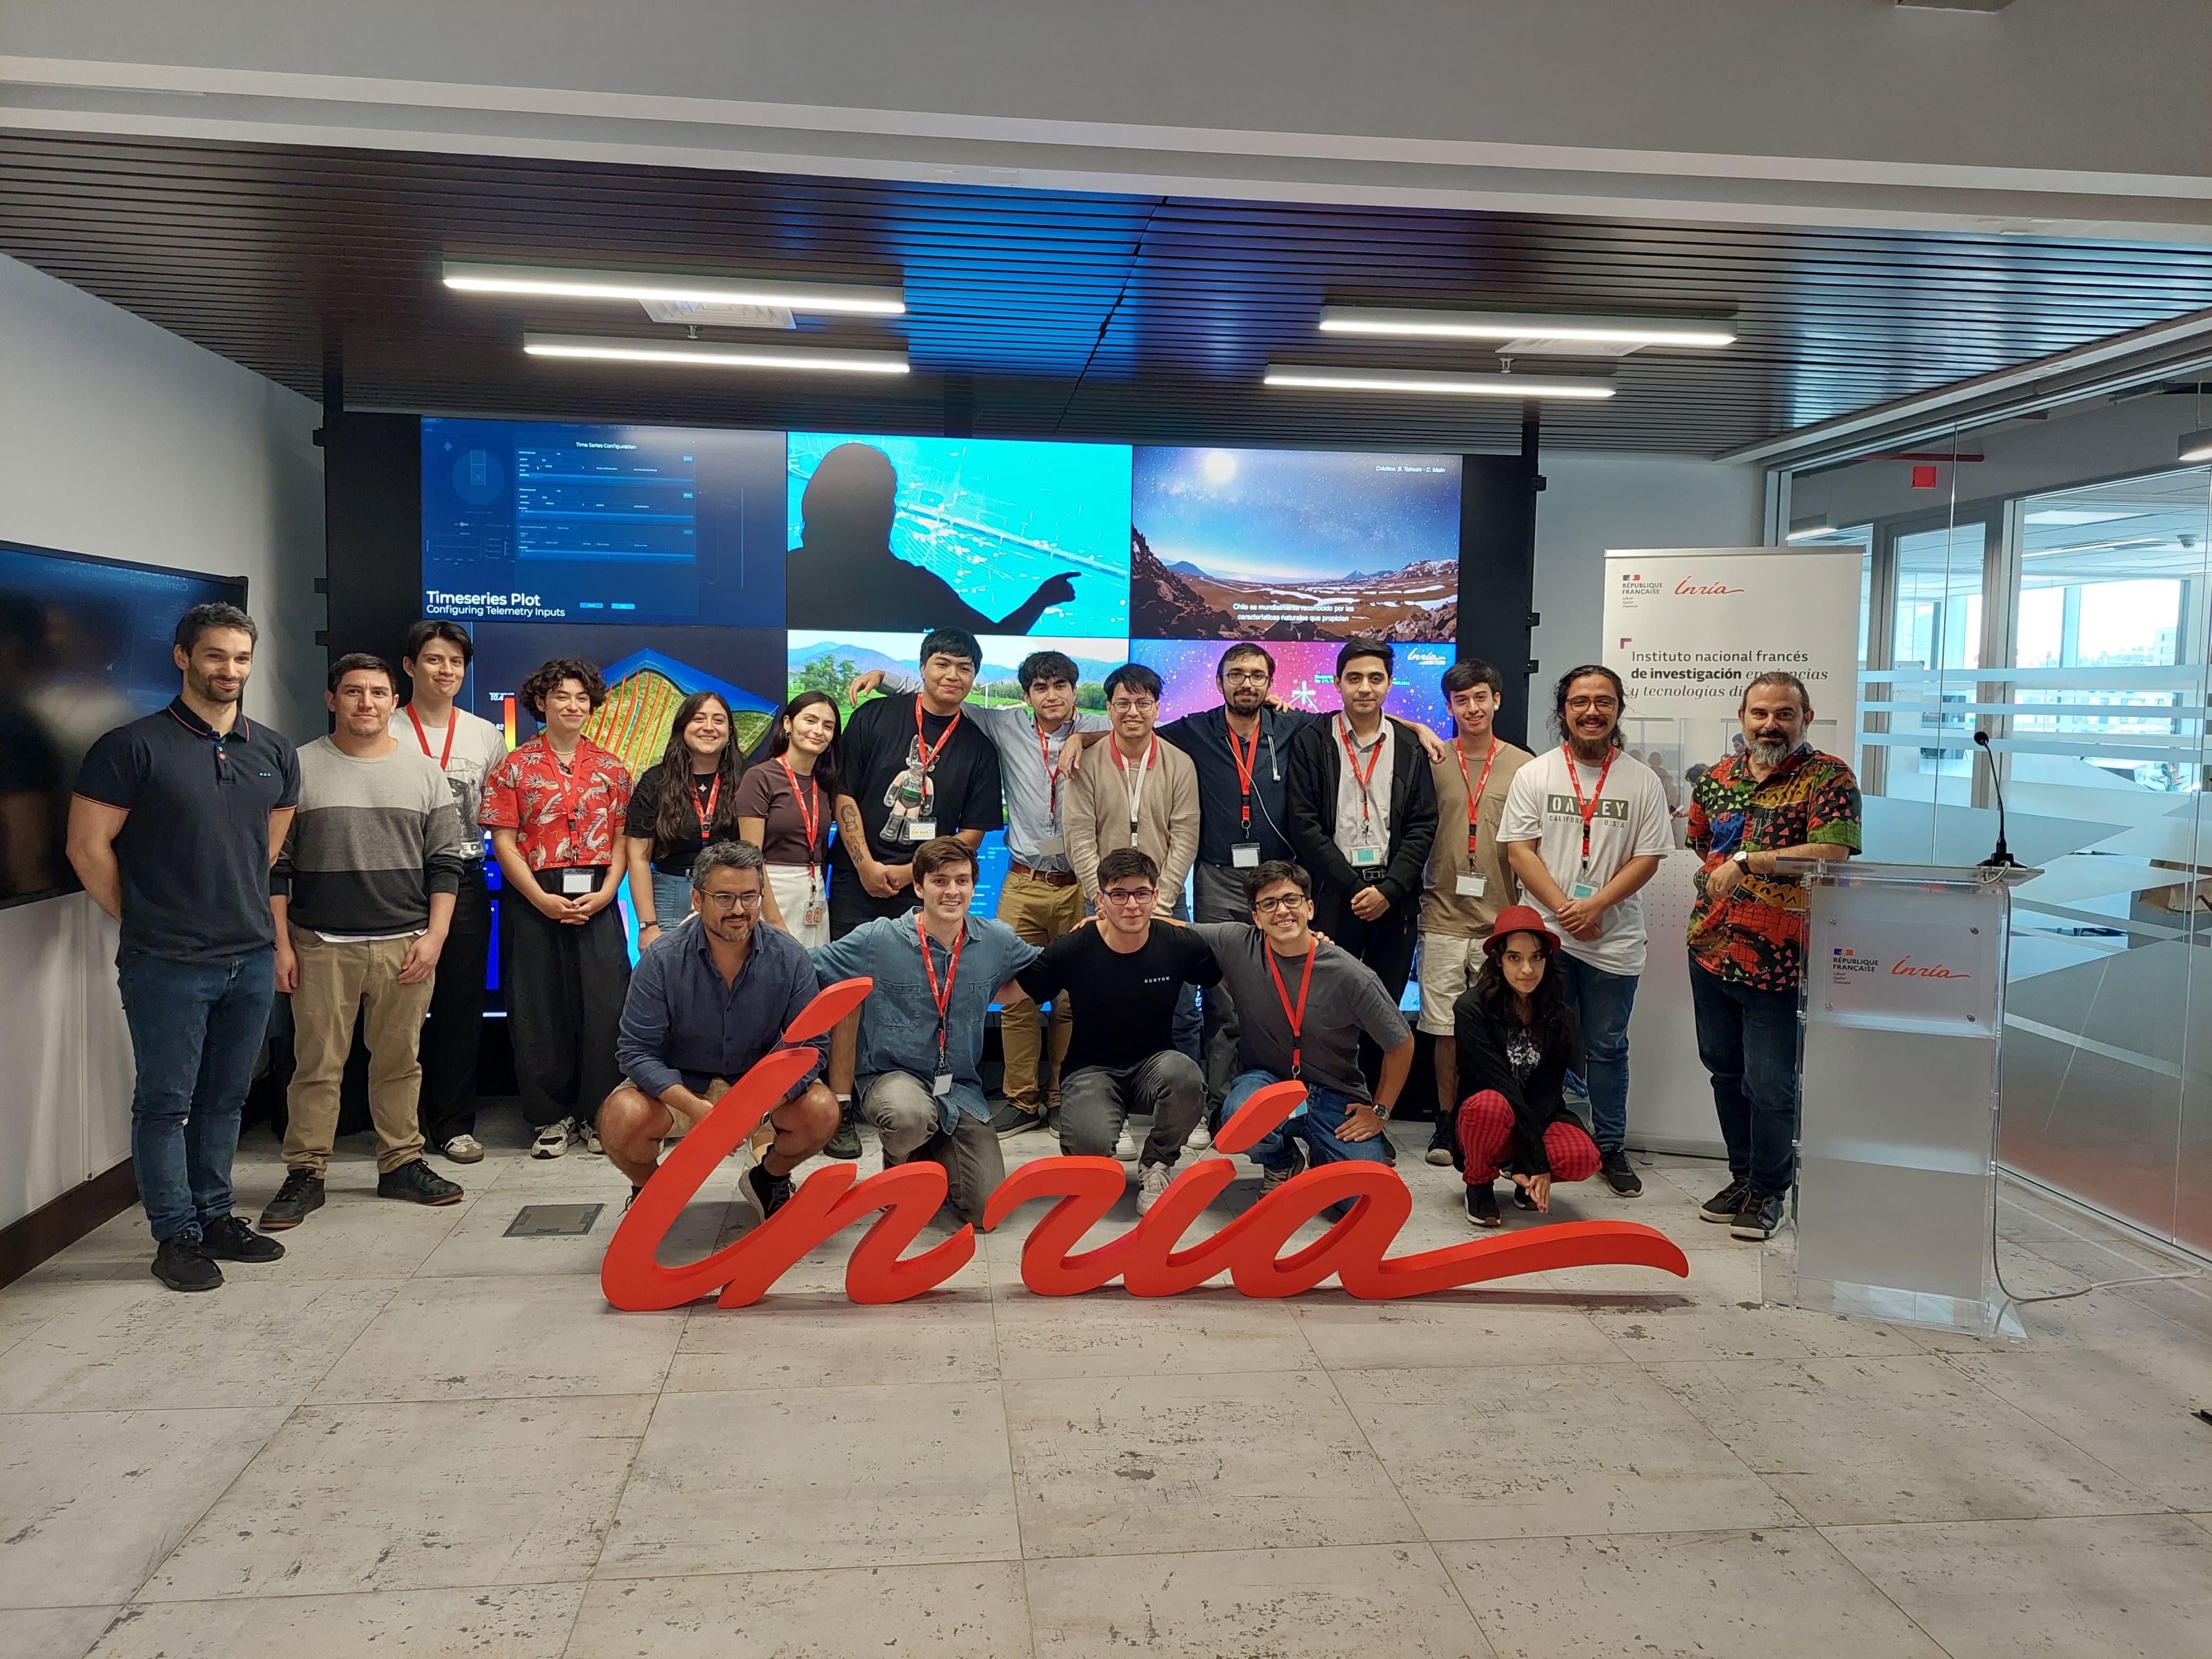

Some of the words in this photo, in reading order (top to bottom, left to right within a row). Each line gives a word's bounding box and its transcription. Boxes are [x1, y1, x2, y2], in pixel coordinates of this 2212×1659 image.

[426, 590, 507, 606] Timeseries
[511, 593, 541, 606] Plot
[426, 605, 484, 616] Configuring
[485, 606, 533, 617] Telemetry
[535, 607, 565, 618] Inputs
[1632, 651, 1691, 662] Instituto
[1696, 650, 1752, 662] nacional
[1756, 650, 1808, 662] francés
[1631, 668, 1647, 679] de
[1650, 668, 1741, 682] investigación
[1630, 688, 1639, 698] y
[1644, 686, 1725, 700] tecnologías
[1552, 797, 1626, 817] OAEY
[1833, 957, 1879, 966] RÉPUBLIQUE
[1833, 964, 1875, 973] FRANÇAISE
